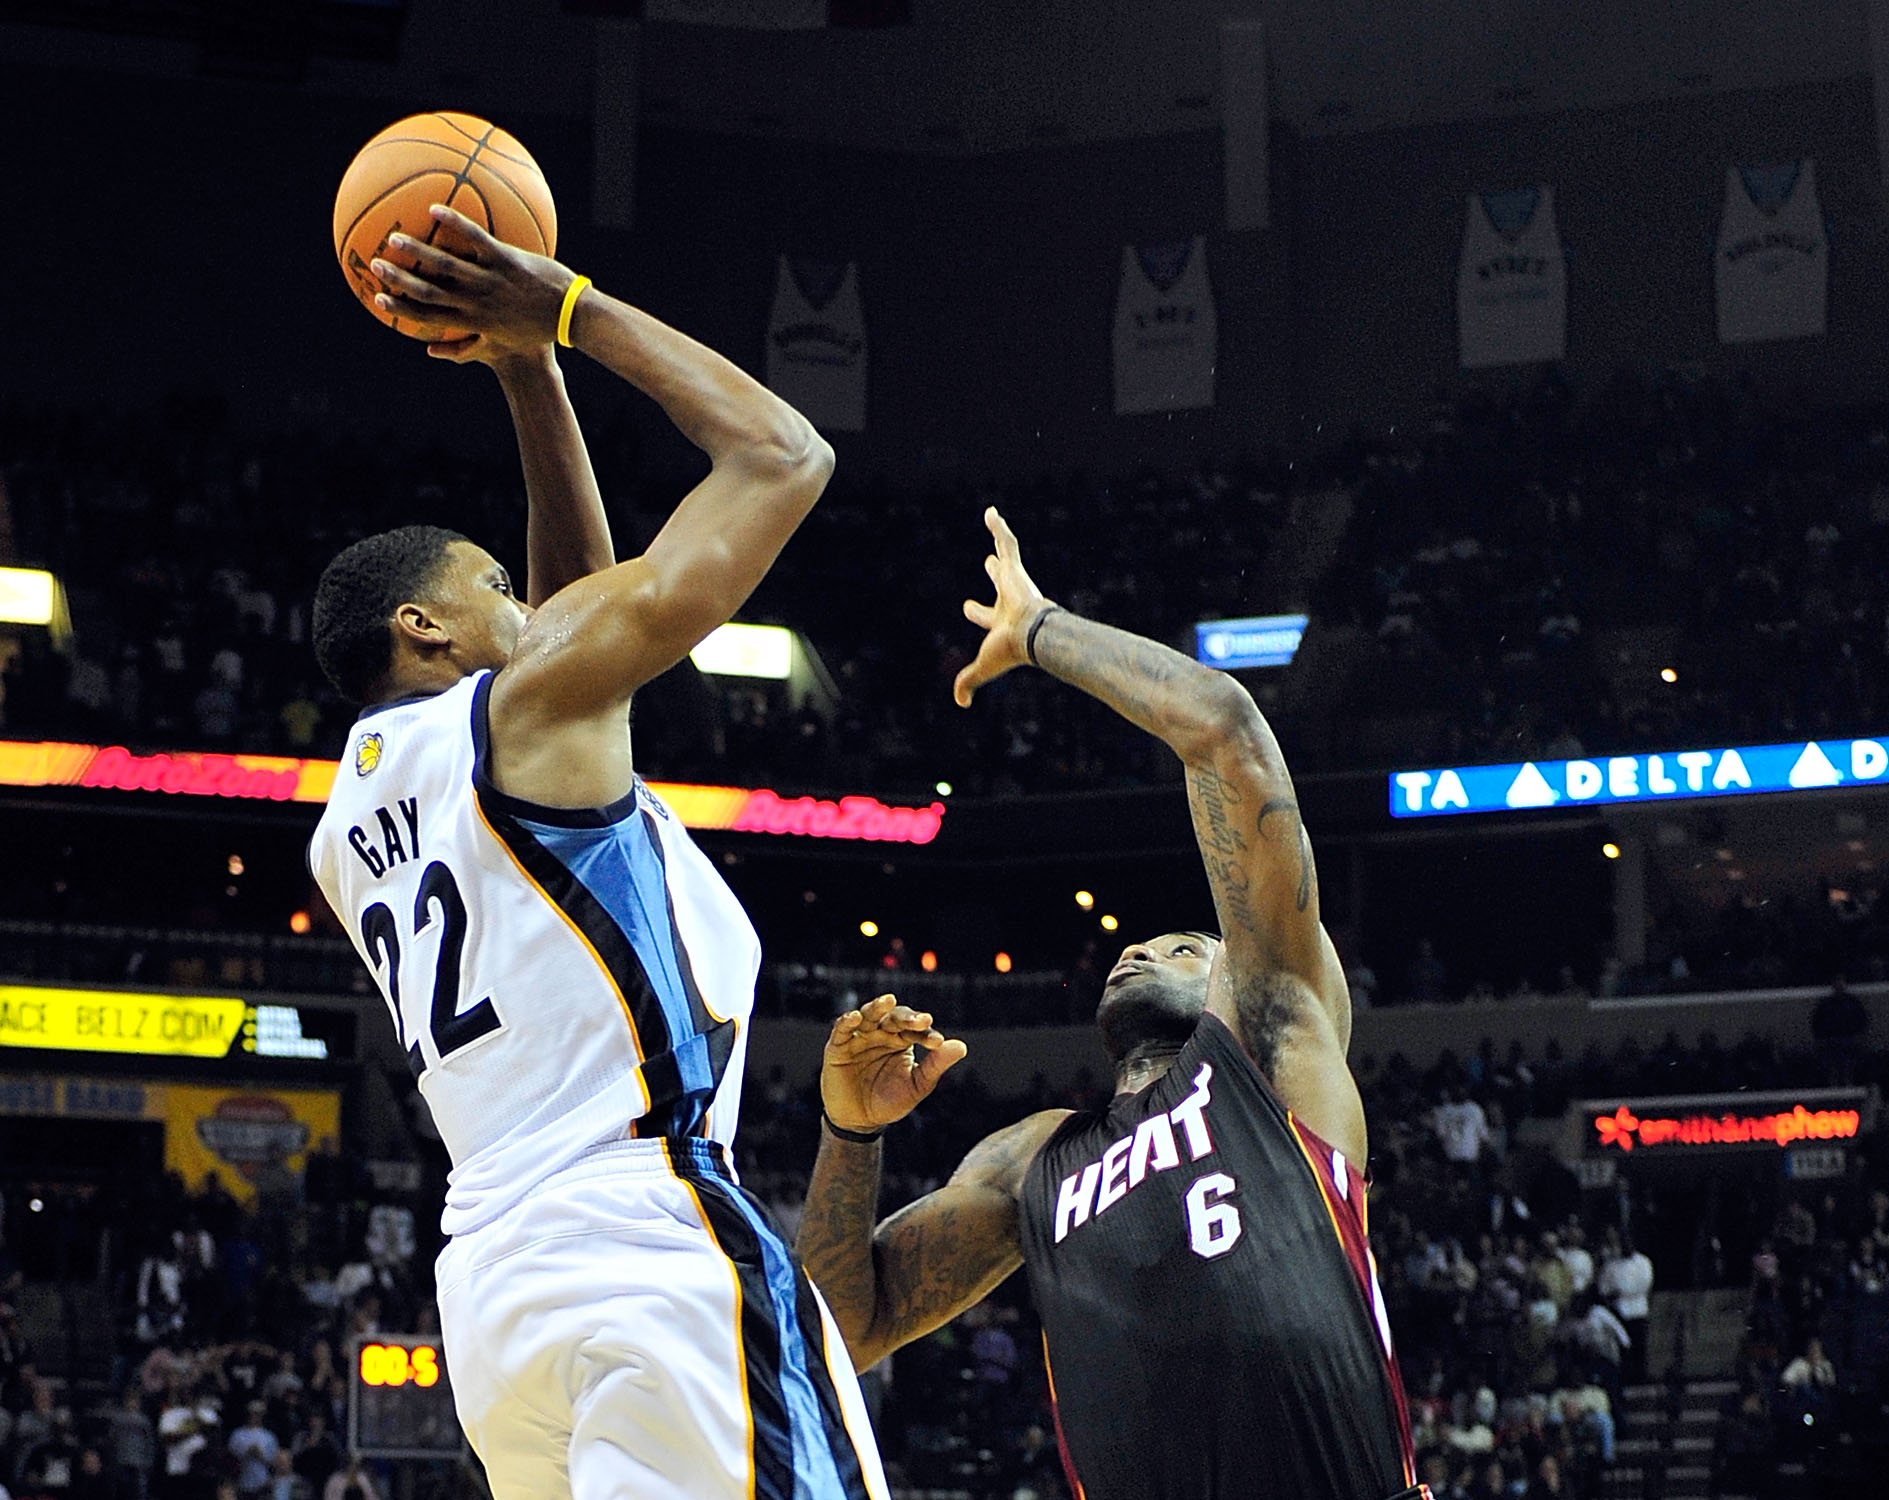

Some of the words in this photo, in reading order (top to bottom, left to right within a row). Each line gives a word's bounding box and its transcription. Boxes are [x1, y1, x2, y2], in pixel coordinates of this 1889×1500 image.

[83, 746, 298, 801] AutoZone
[1397, 771, 1469, 811] TA
[1566, 749, 1751, 800] DELTA
[348, 797, 420, 879] GAY
[733, 789, 945, 844] AutoZone
[361, 860, 502, 1080] 22
[1054, 1061, 1215, 1244] HEAT
[1185, 1172, 1243, 1259] 6
